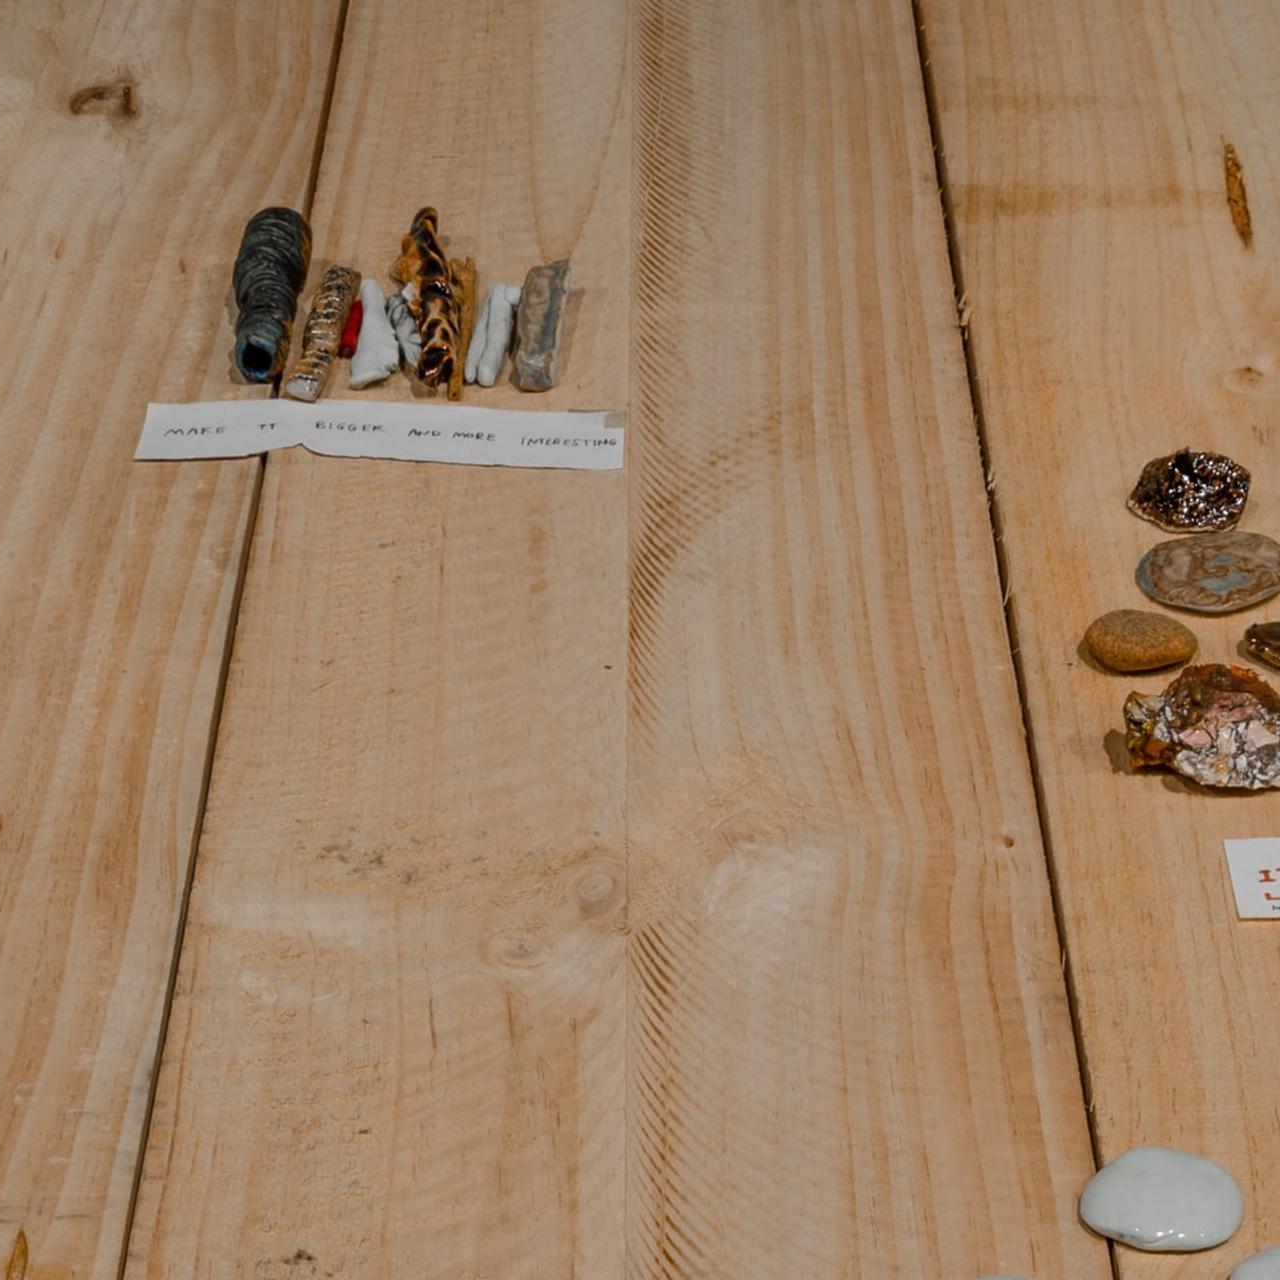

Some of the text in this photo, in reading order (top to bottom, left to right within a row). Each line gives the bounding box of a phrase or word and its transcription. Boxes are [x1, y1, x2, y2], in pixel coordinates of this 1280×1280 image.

[163, 420, 617, 448] MAKE IT BIGGER AND MORE INTERESTING
